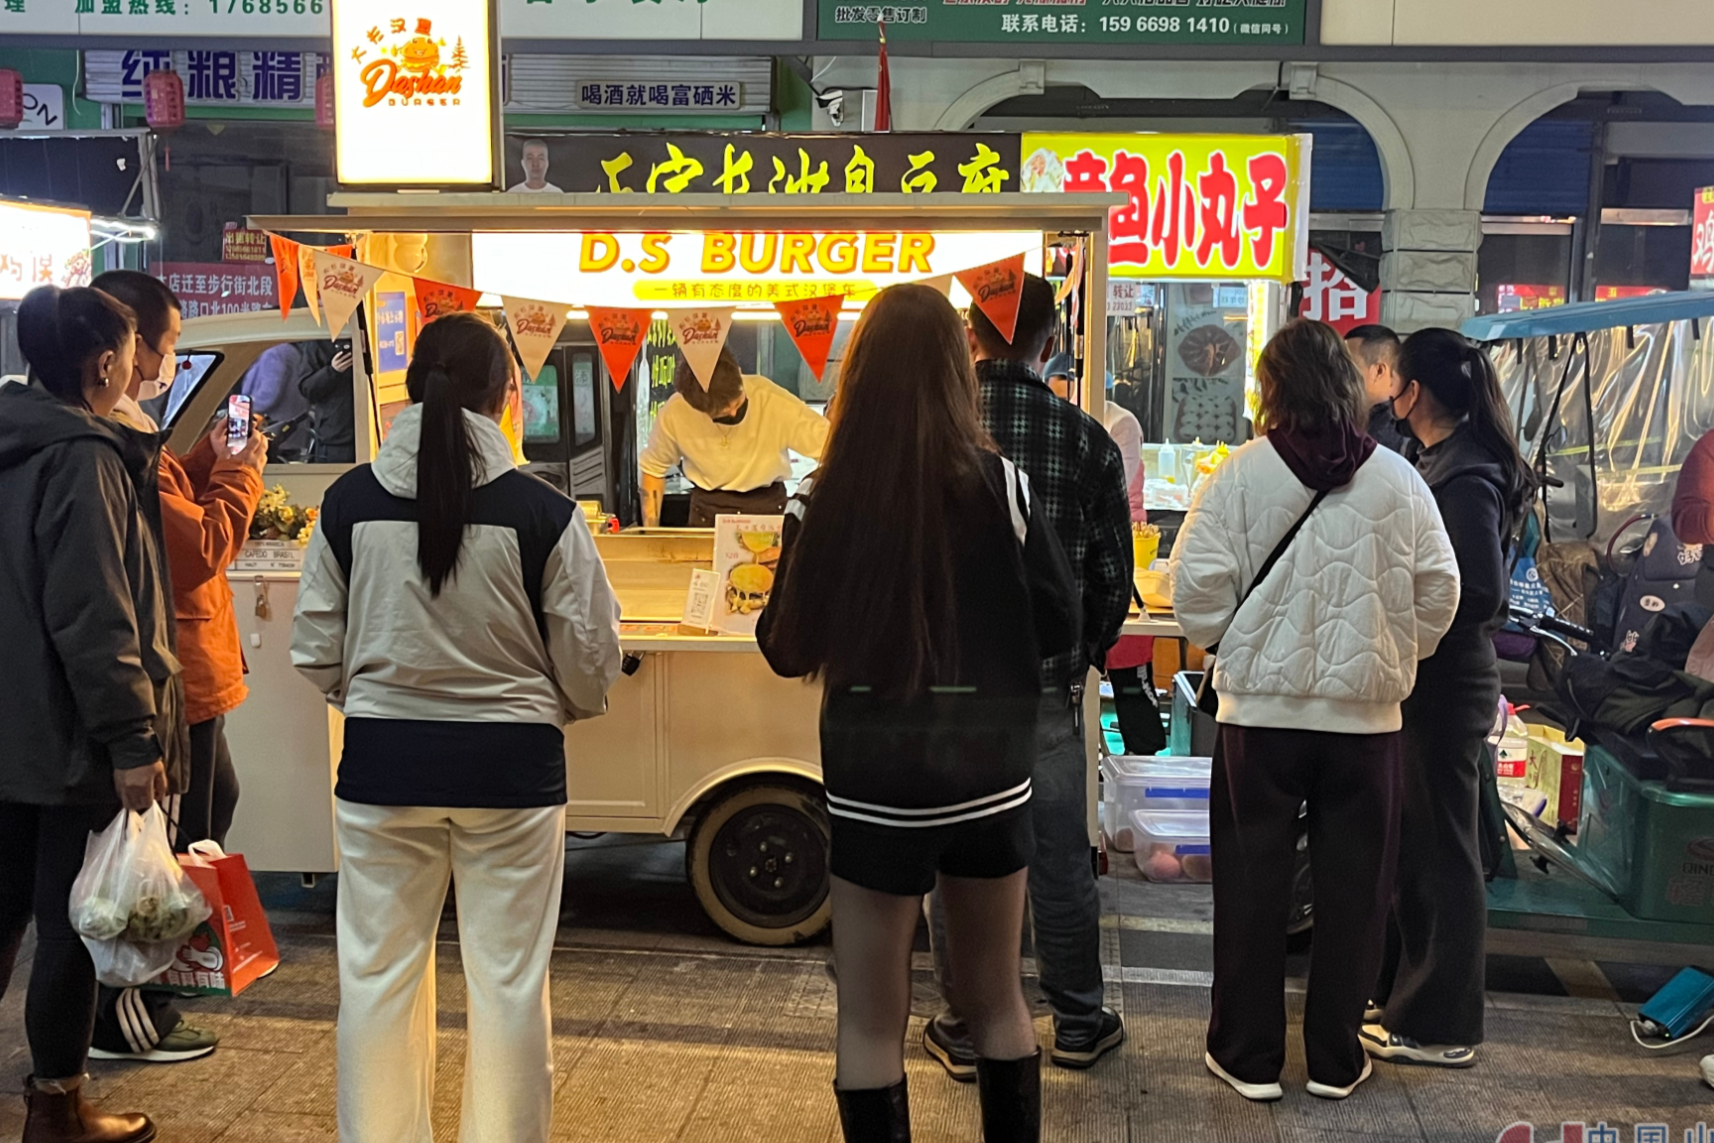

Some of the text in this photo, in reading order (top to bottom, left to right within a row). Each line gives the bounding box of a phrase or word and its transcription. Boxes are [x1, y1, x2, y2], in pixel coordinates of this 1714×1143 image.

[835, 6, 927, 23] 批发零售订制
[1099, 16, 1131, 32] 159
[1136, 16, 1180, 32] 6698
[1187, 17, 1230, 33] 1410
[122, 51, 332, 101] 纯粮精
[360, 58, 462, 108] Dashan
[581, 83, 737, 106] 喝酒就喝富硒米
[579, 233, 936, 273] D.S BURGER
